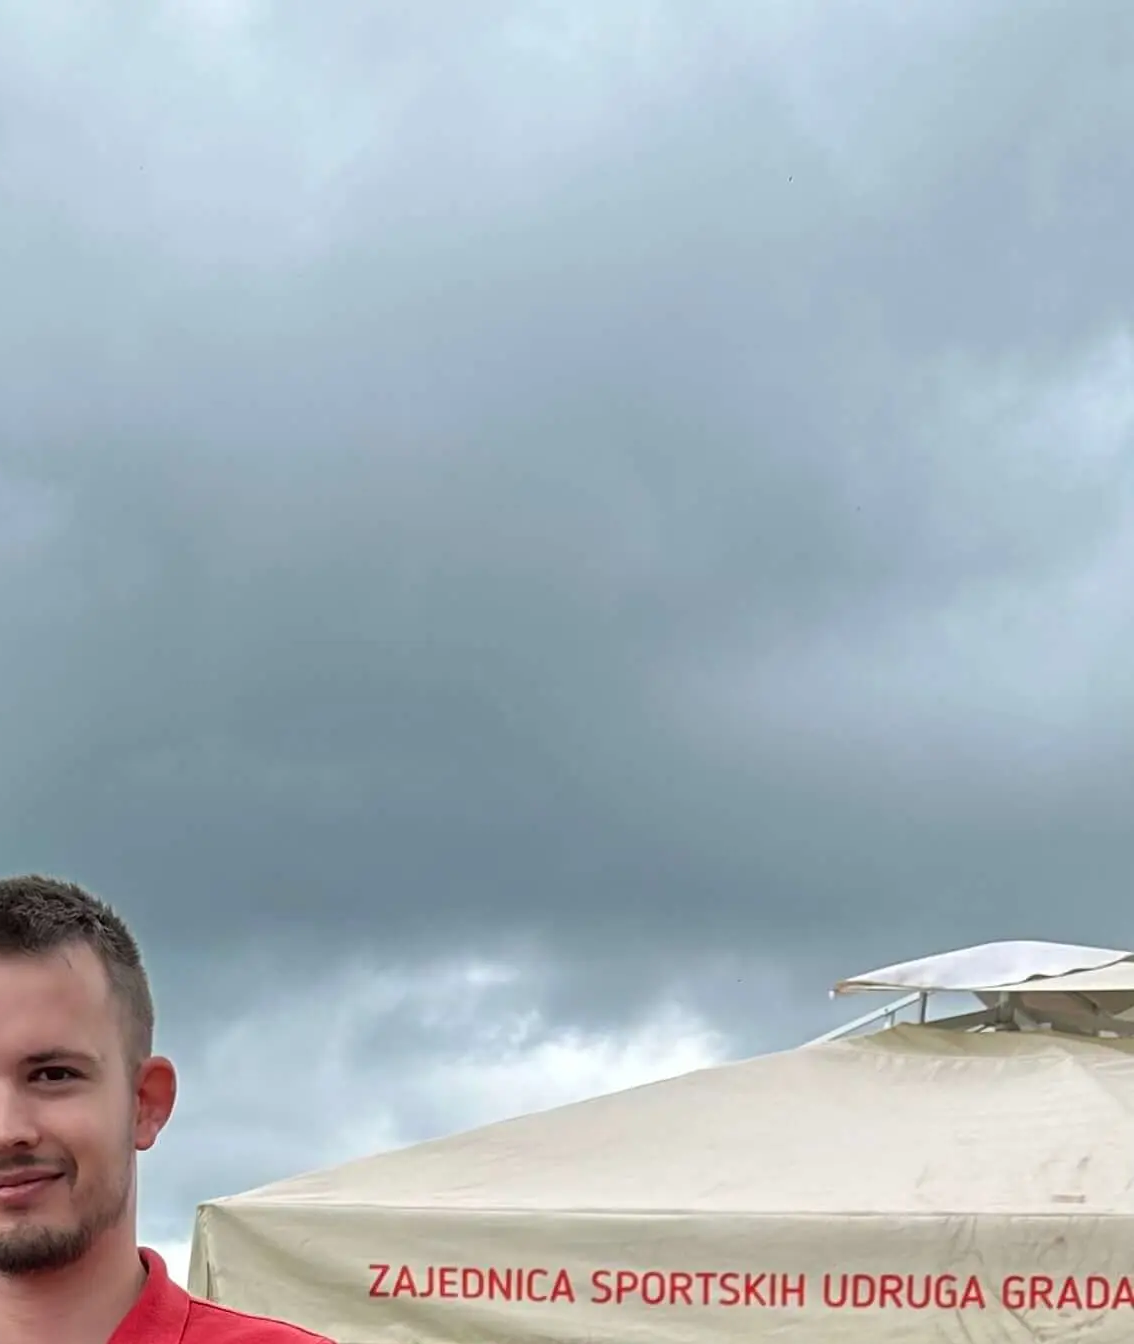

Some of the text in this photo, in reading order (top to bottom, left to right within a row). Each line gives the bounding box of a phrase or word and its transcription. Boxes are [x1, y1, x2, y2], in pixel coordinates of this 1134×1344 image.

[368, 1263, 1134, 1311] ZAJEDNICA SPORTSKIH UDRUGA GRADA
